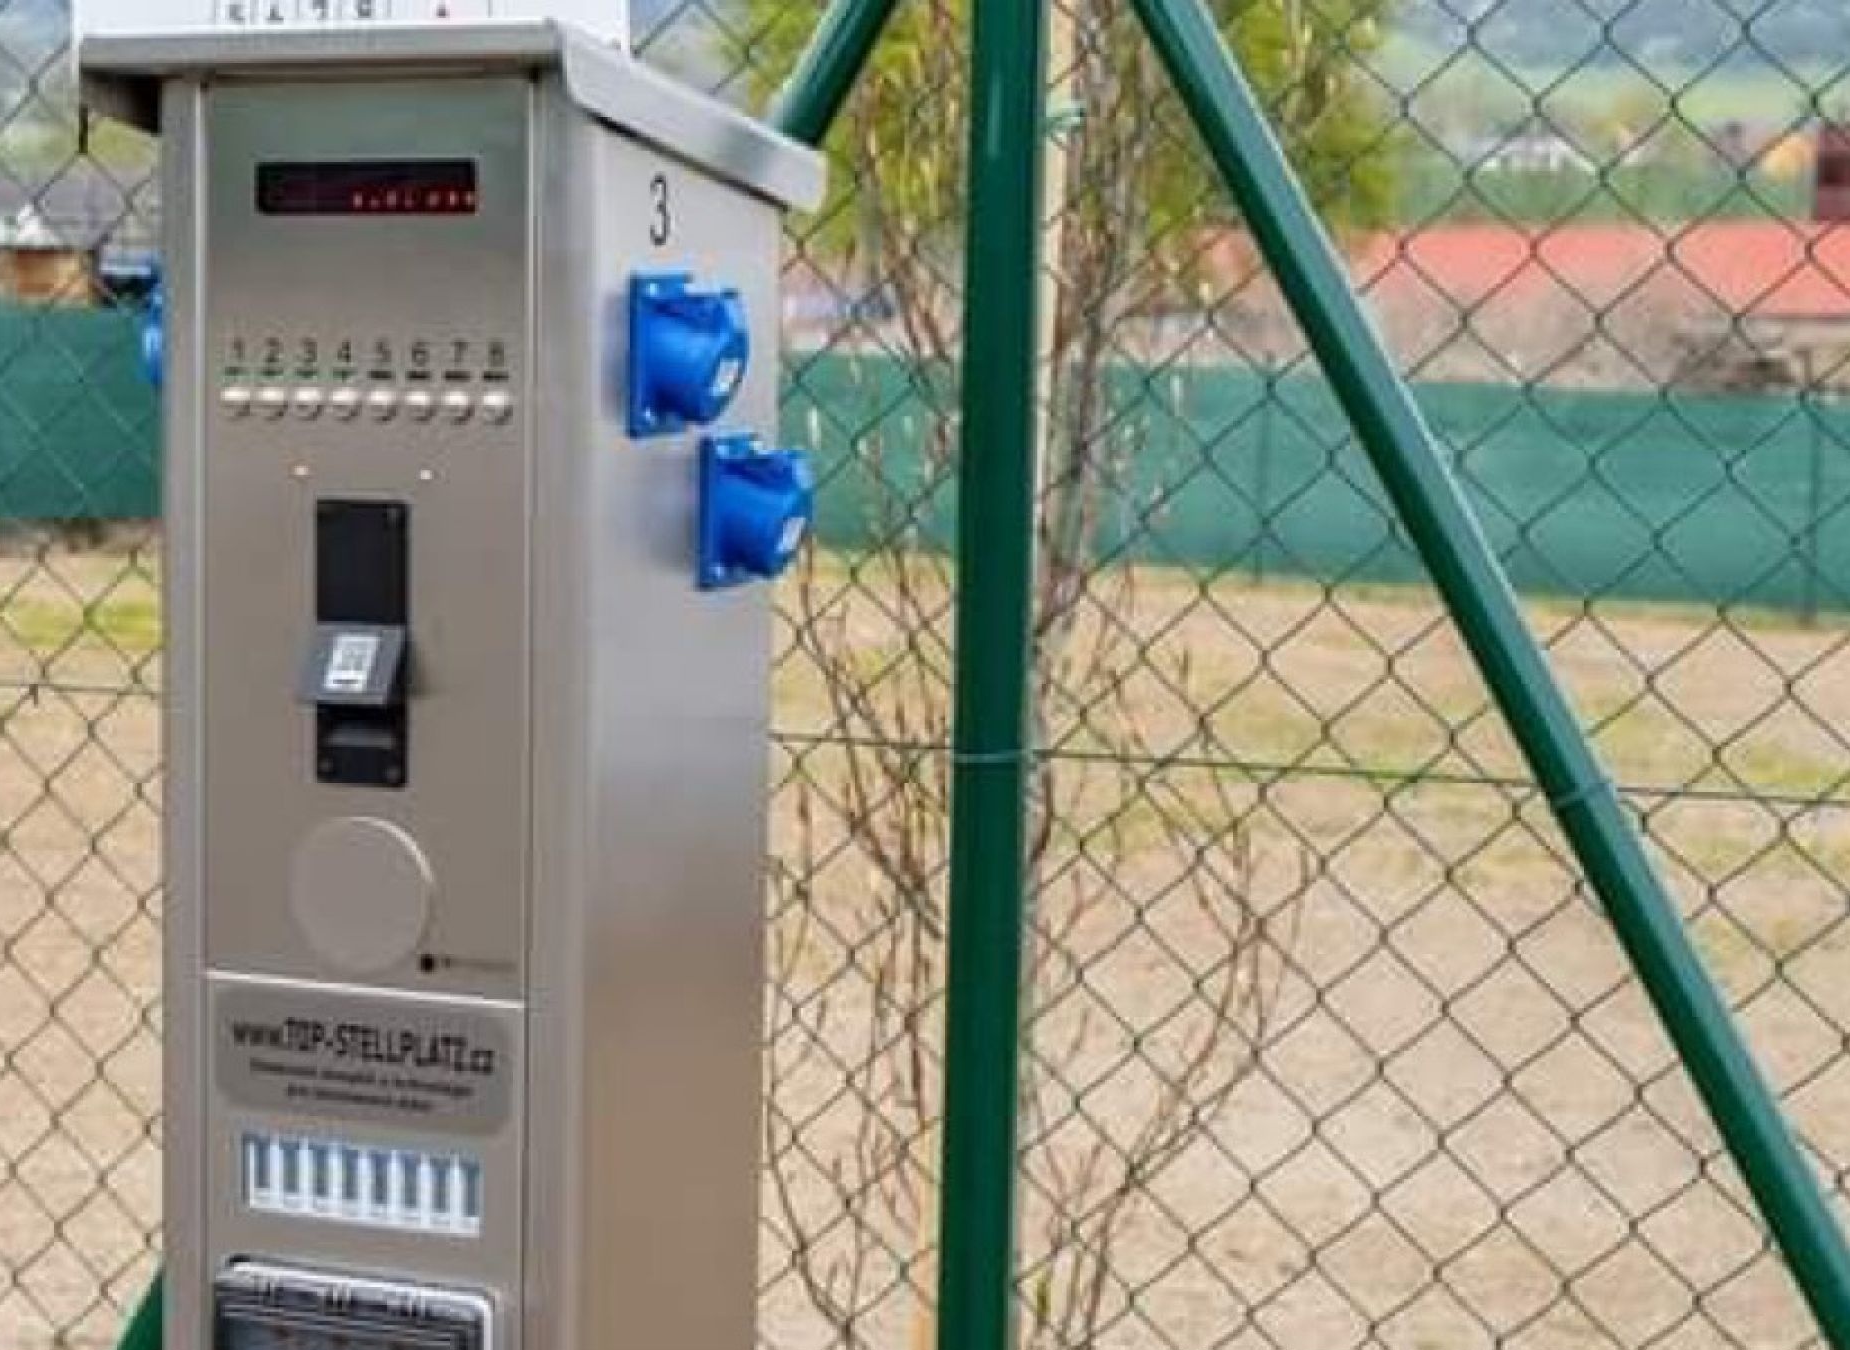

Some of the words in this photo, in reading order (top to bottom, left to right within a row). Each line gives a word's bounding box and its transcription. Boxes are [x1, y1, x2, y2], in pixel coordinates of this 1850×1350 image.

[649, 174, 670, 246] 3
[232, 337, 245, 361] 1
[263, 337, 282, 363] 2
[301, 338, 317, 364] 3
[337, 339, 352, 363] 4
[373, 338, 391, 364] 5
[411, 340, 429, 366] 6
[453, 340, 469, 365] 7
